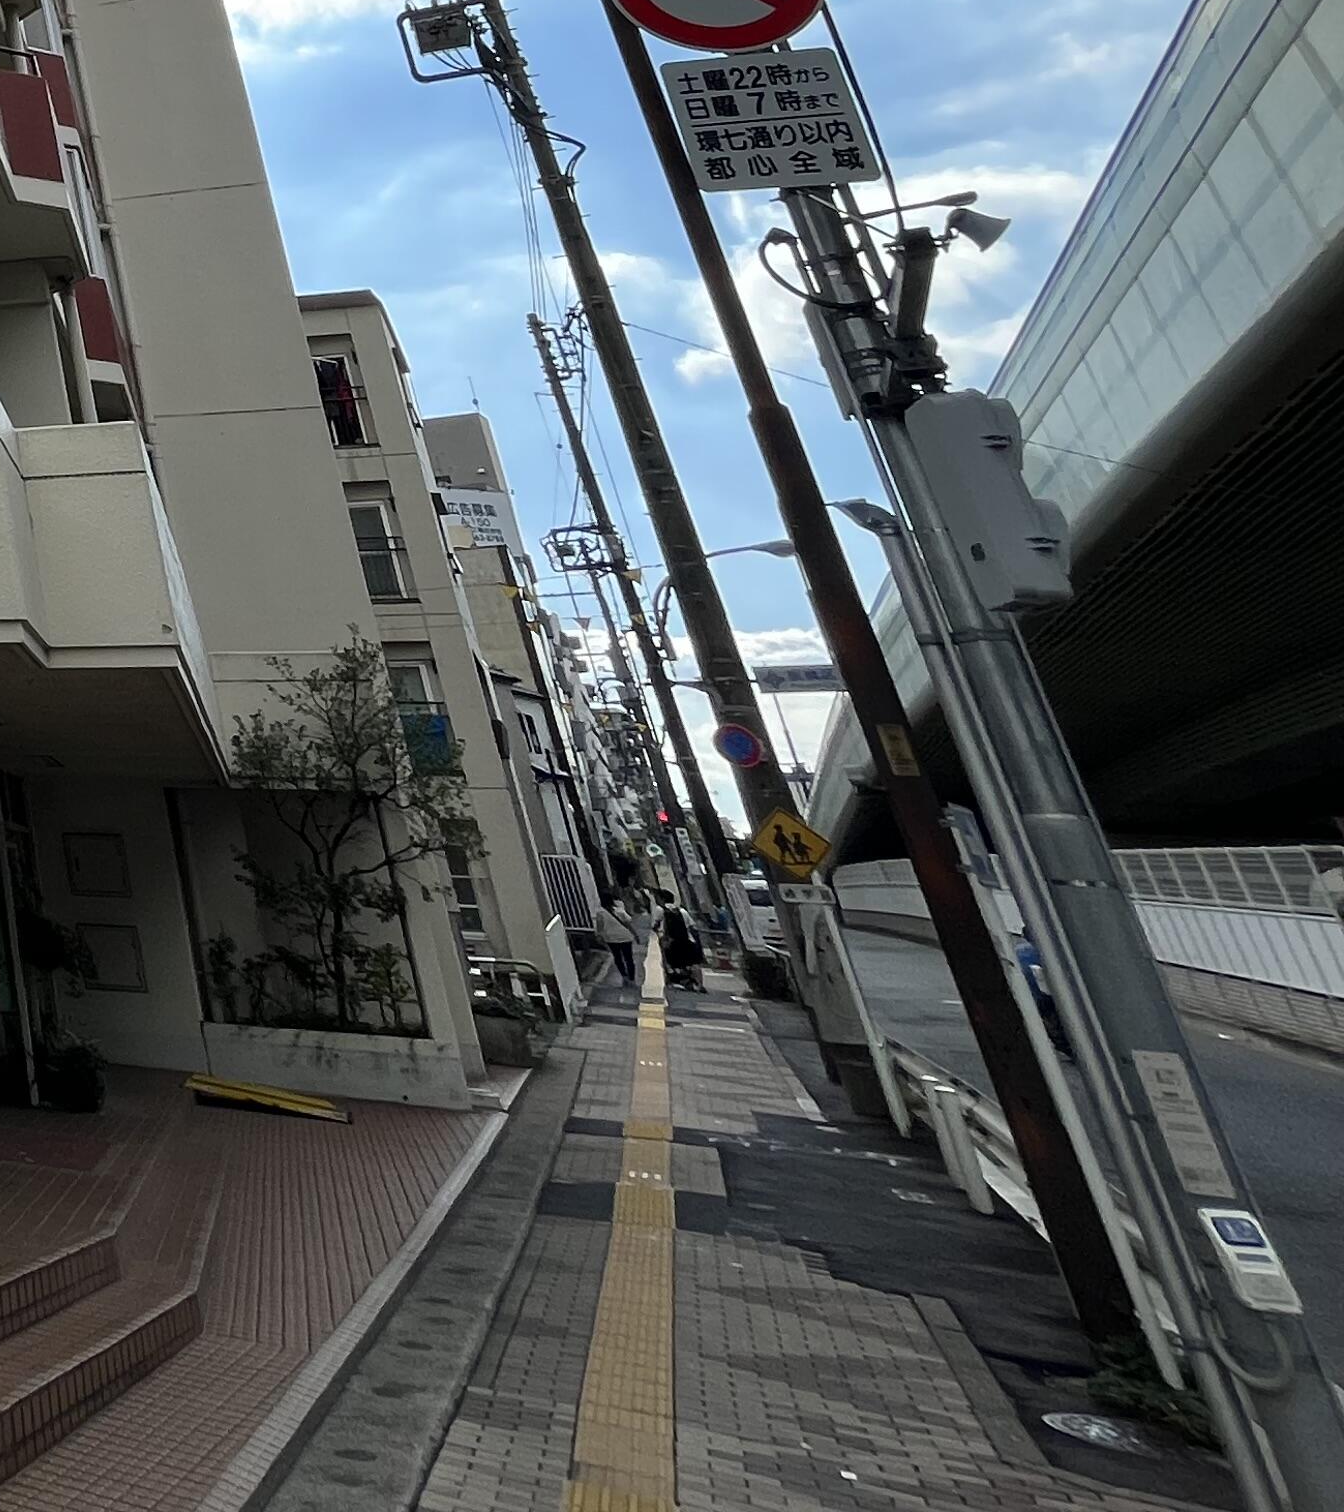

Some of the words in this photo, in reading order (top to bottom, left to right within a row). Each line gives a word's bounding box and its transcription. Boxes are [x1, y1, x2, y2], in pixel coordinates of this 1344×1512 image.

[694, 119, 855, 153] 環七通り以内
